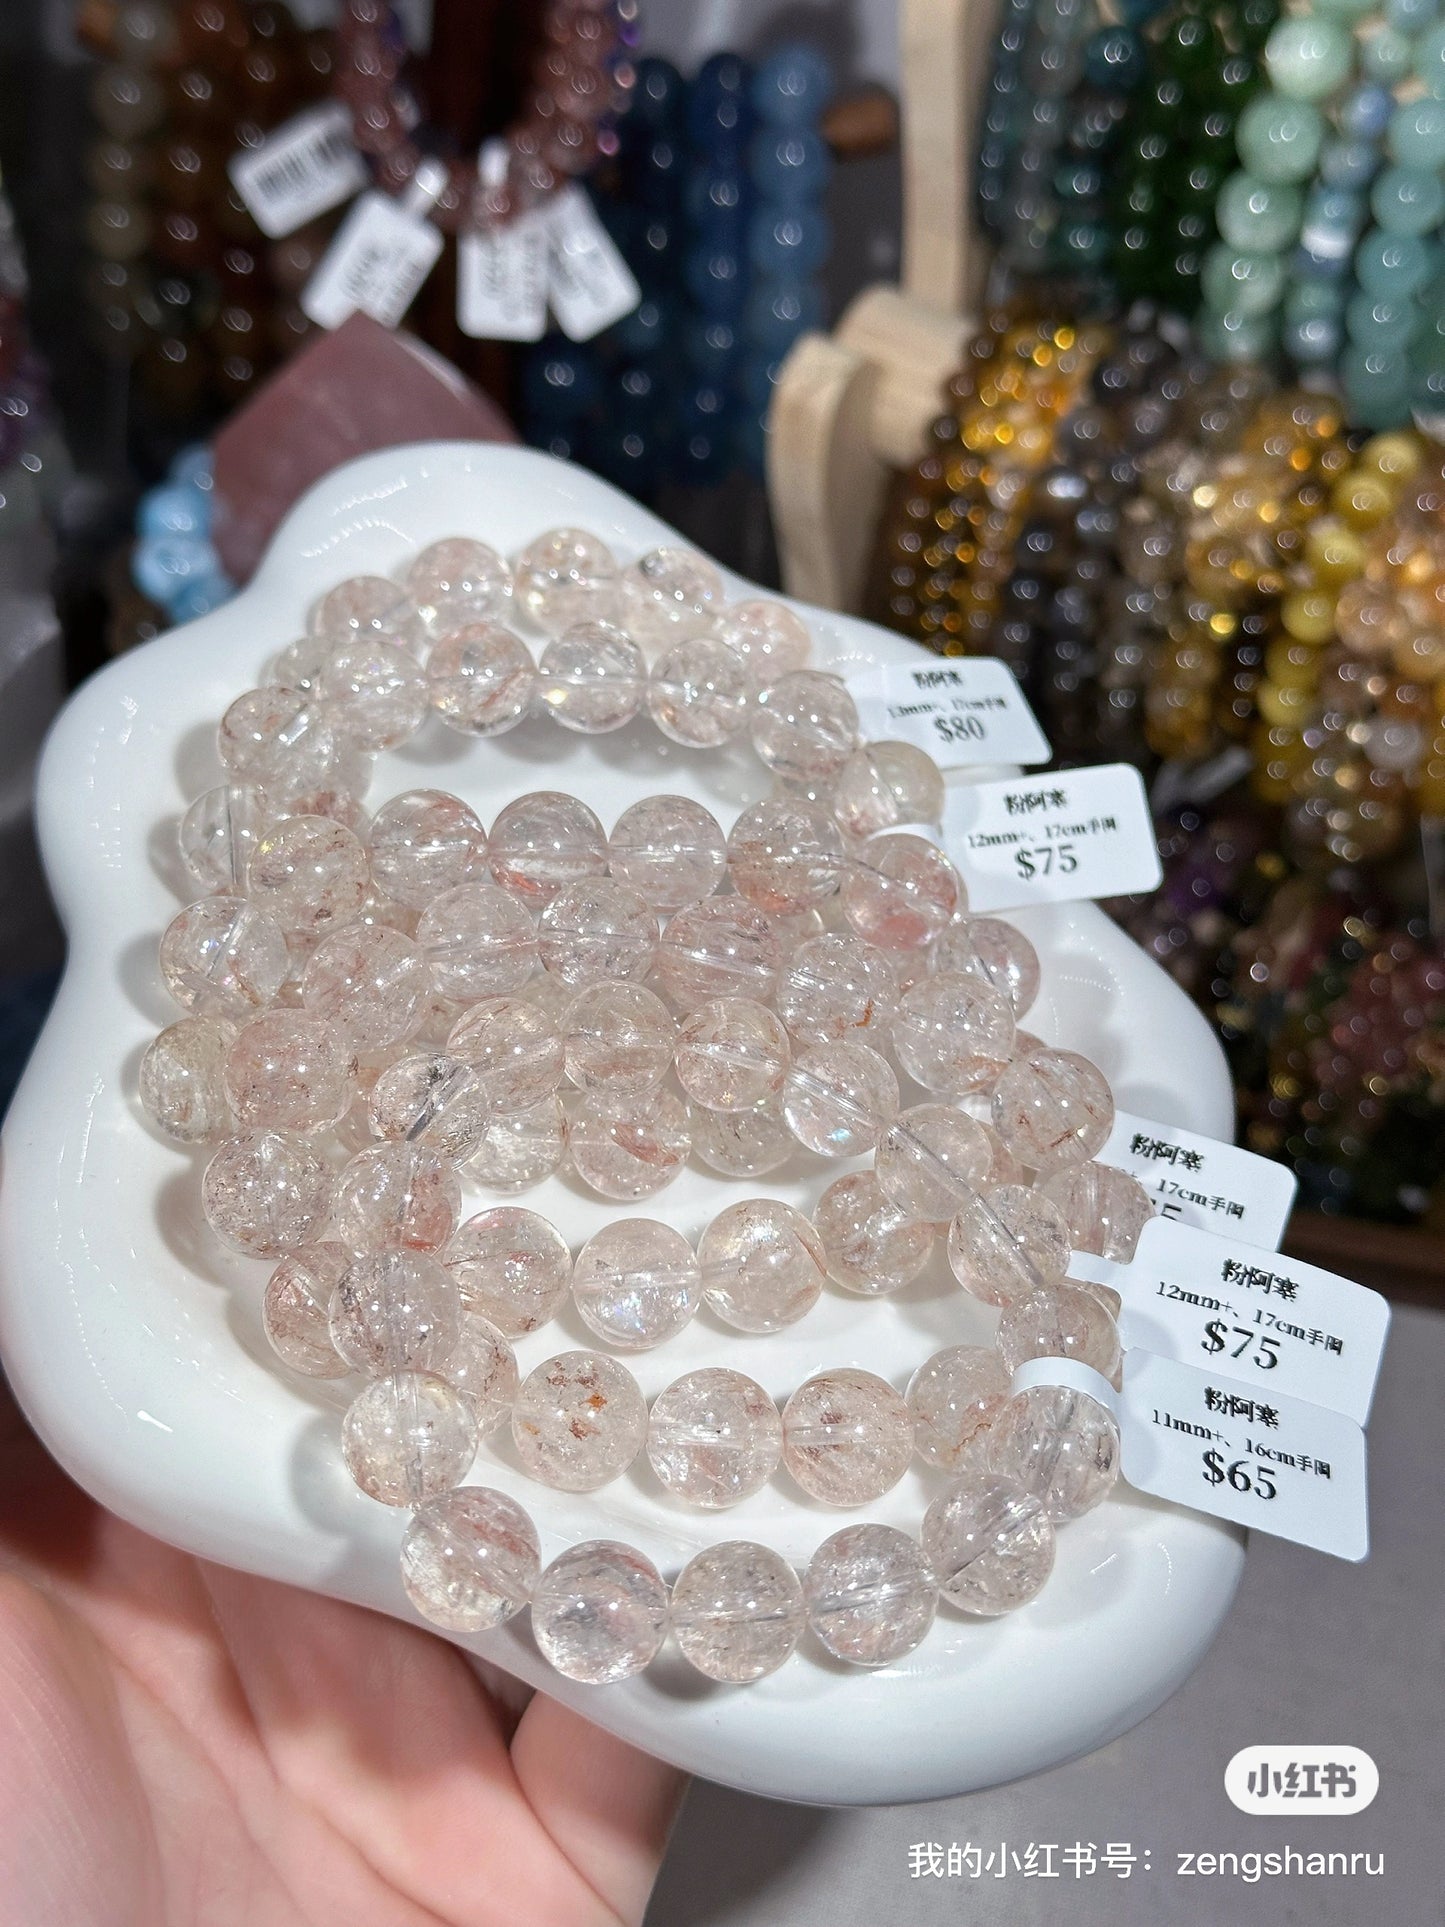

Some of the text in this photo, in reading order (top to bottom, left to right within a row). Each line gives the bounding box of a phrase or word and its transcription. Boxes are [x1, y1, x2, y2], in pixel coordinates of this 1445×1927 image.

[934, 716, 985, 742] $80
[1015, 844, 1078, 880] $75
[1130, 1133, 1205, 1172] 粉阿塞
[1221, 1259, 1300, 1302] 粉阿塞
[1201, 1318, 1282, 1370] $75
[1204, 1386, 1280, 1430] 粉阿塞
[1202, 1448, 1277, 1500] $65
